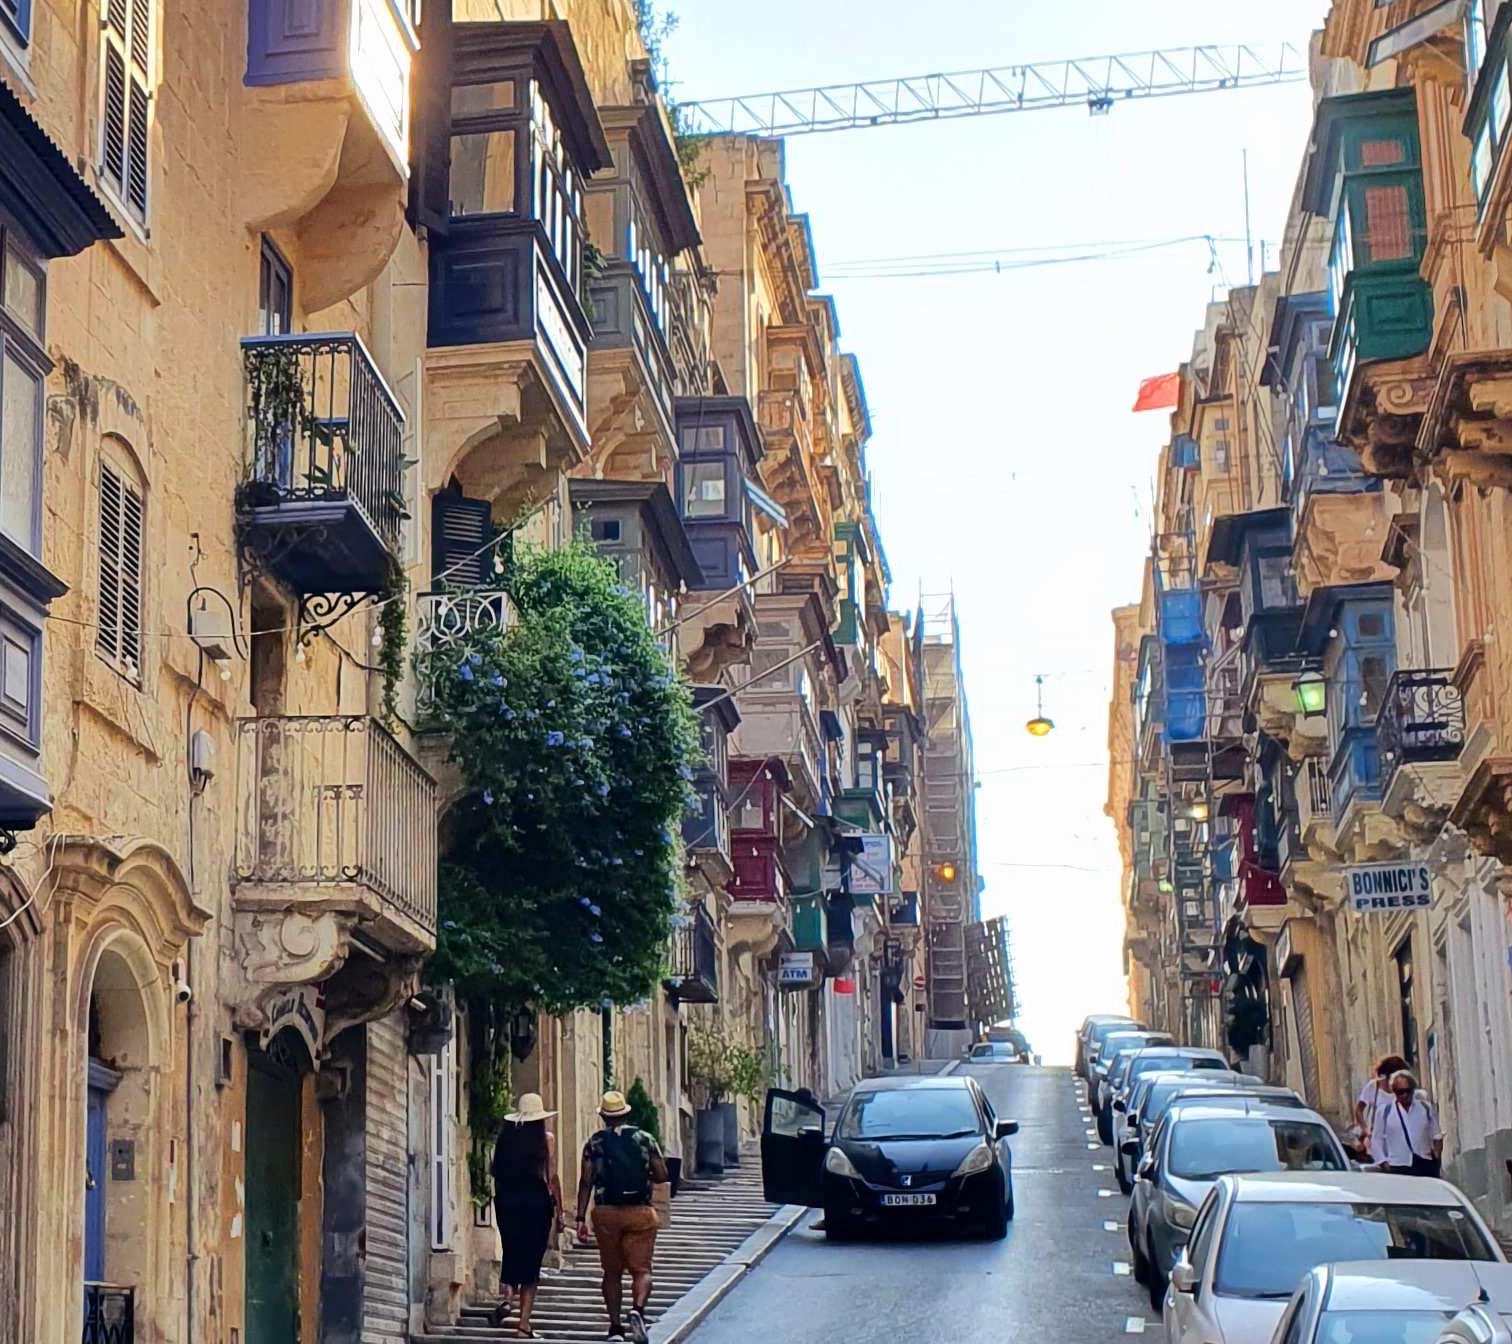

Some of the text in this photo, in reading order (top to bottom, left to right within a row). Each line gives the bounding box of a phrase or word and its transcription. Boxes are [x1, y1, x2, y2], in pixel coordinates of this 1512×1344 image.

[1352, 867, 1429, 895] BONNICI'S
[1356, 894, 1430, 910] PRESS
[782, 969, 808, 979] ATM
